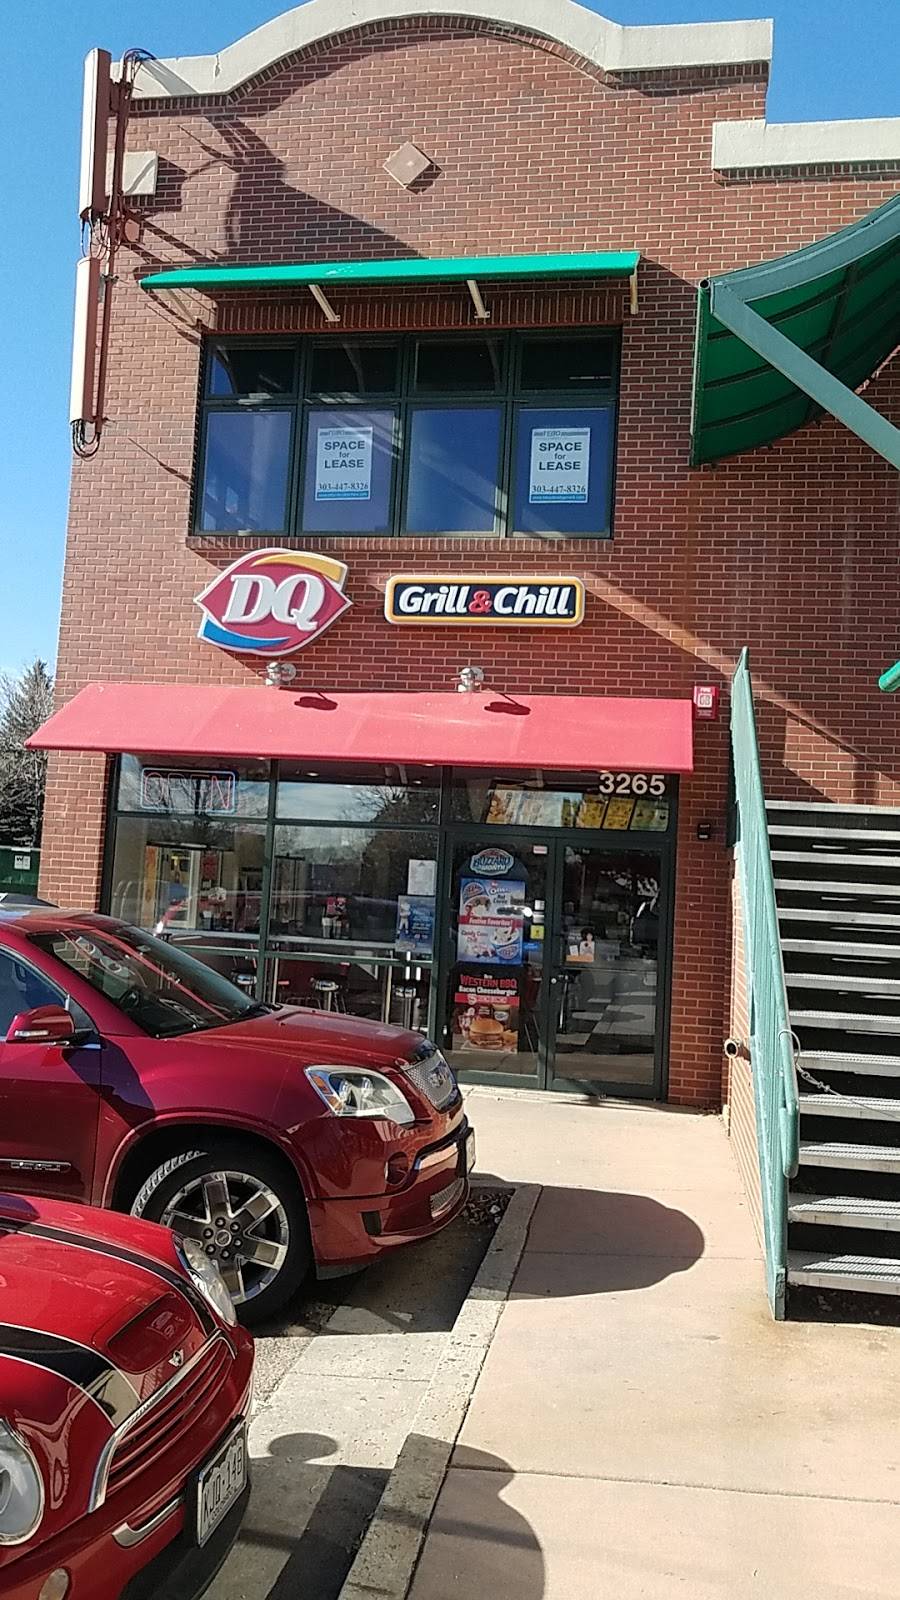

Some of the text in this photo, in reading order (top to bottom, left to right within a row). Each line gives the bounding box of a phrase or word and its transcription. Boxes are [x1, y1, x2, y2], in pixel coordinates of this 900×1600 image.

[324, 440, 366, 451] SPACE
[538, 441, 583, 452] SPACE
[554, 452, 567, 460] for
[324, 459, 365, 469] LEASE
[538, 461, 581, 471] LEASE
[531, 484, 586, 493] 303-447-8326
[221, 573, 325, 632] DQ
[398, 585, 572, 615] Grill & Chill
[598, 772, 666, 796] 3265
[143, 772, 233, 810] OPEN
[460, 974, 518, 989] WESTERN BBQ
